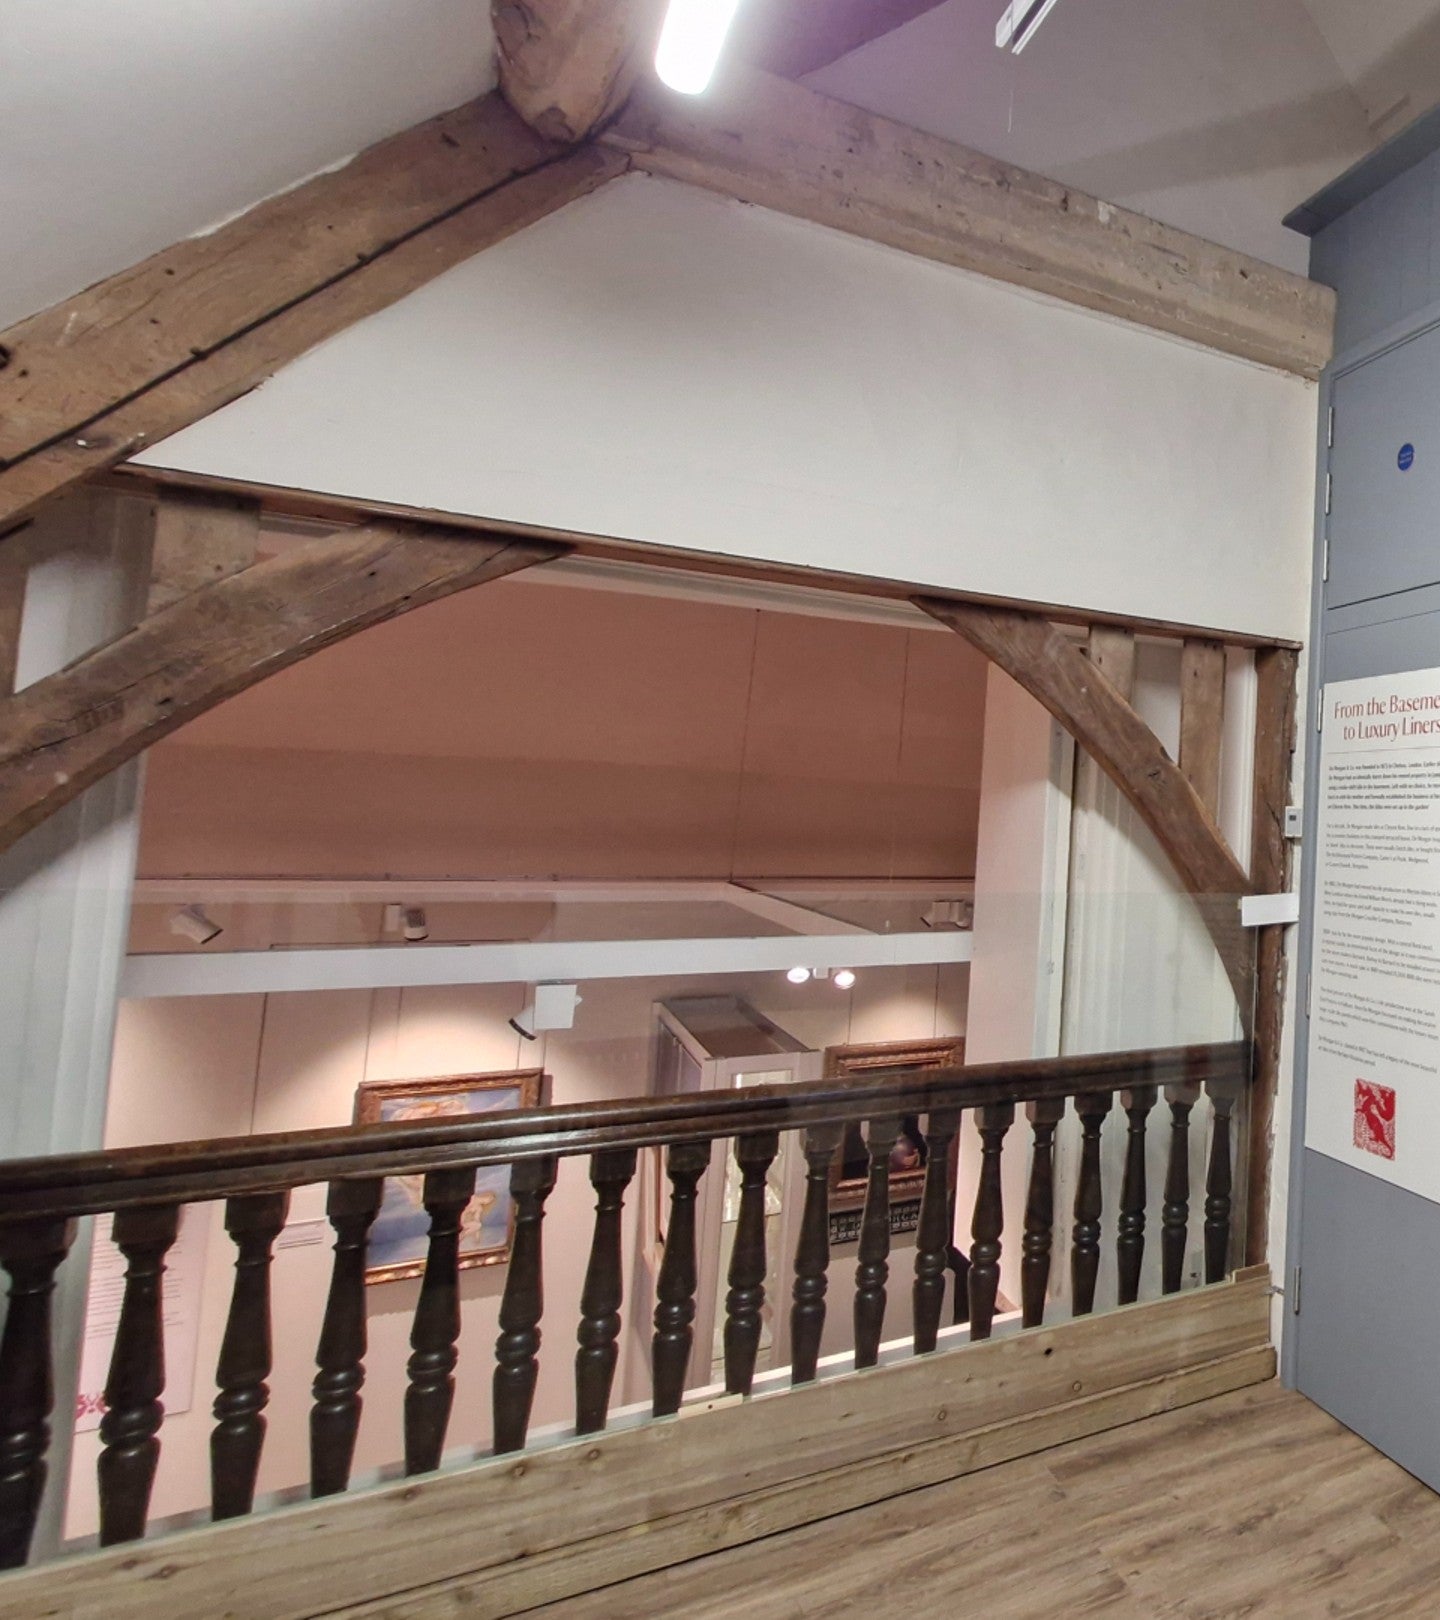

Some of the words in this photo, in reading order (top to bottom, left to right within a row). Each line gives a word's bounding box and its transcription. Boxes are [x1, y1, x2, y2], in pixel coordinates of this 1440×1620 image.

[1334, 701, 1364, 719] From
[1367, 697, 1387, 716] the
[1343, 725, 1355, 740] to
[1358, 721, 1400, 742] Luxury
